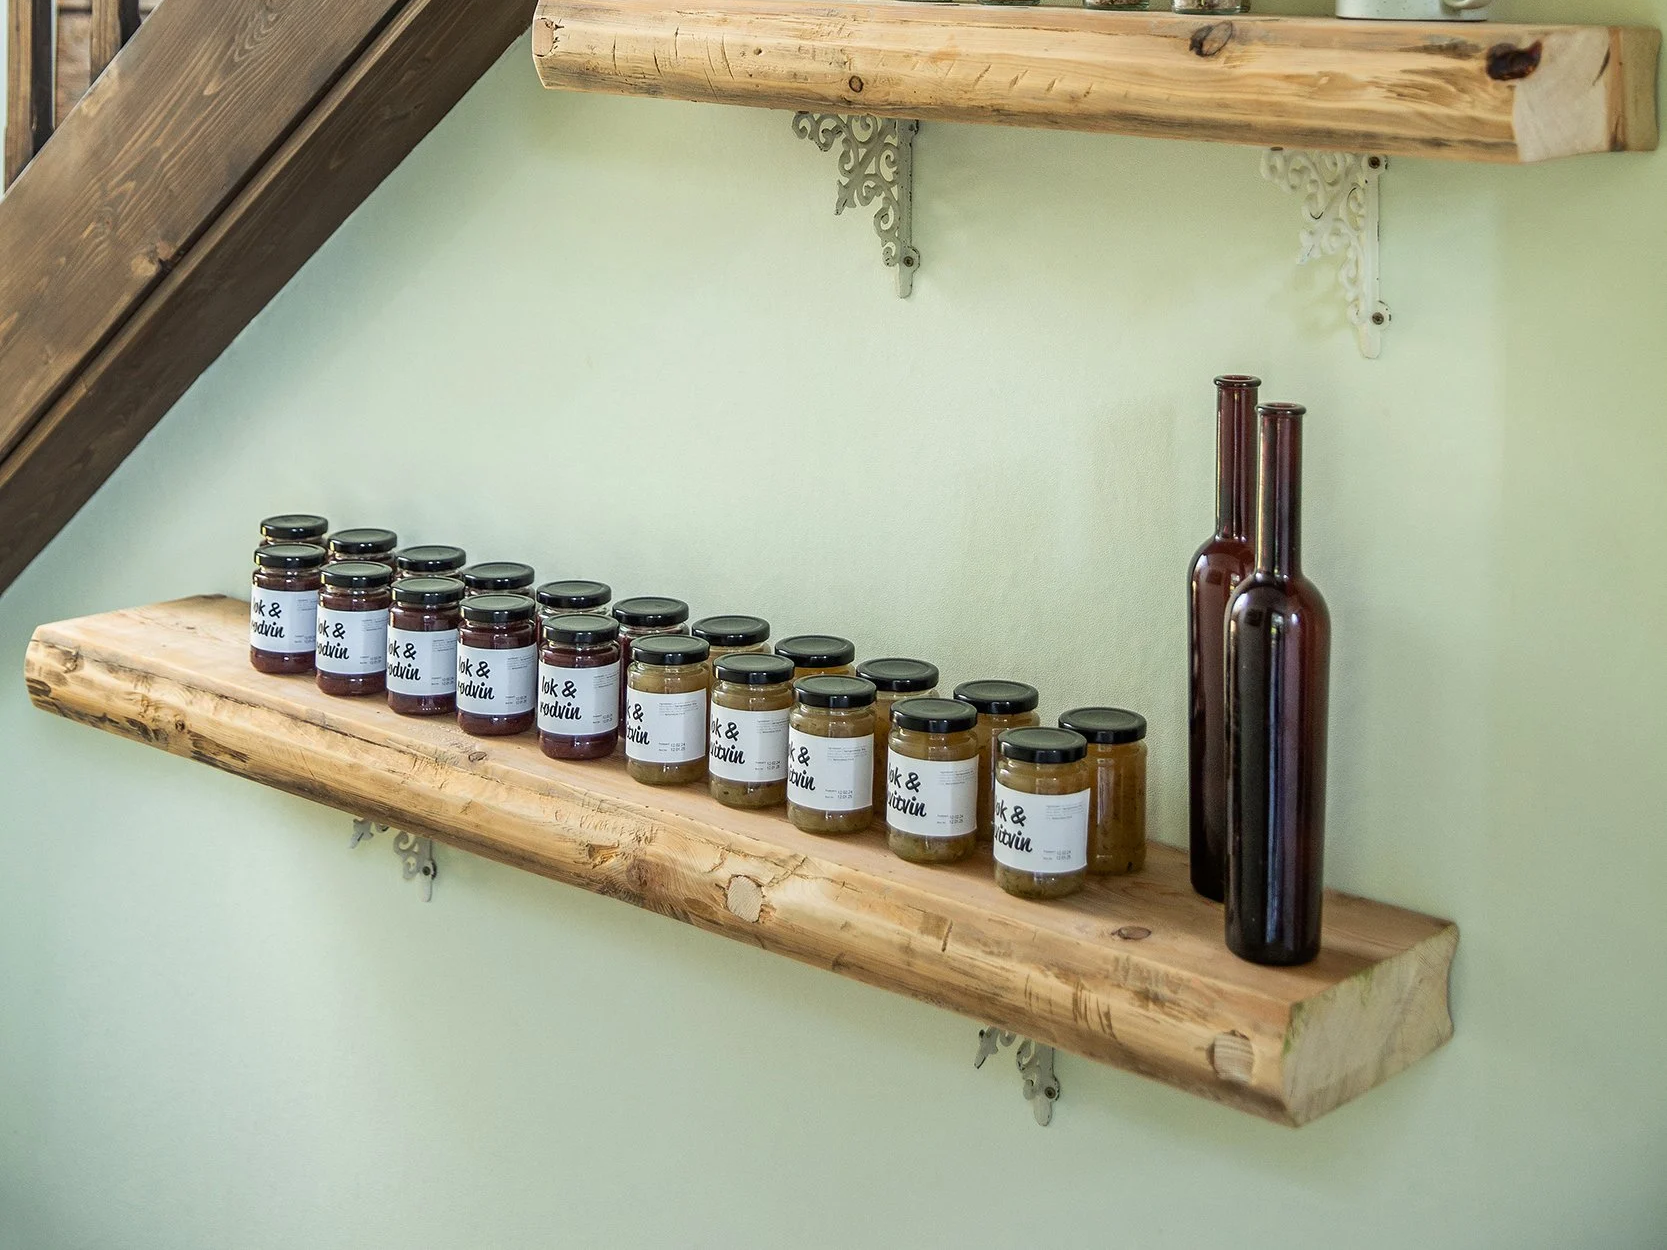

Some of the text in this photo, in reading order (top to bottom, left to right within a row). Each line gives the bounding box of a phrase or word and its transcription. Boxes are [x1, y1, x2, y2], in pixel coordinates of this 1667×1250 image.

[268, 602, 282, 619] &
[332, 622, 346, 640] &
[403, 642, 417, 660] &
[475, 661, 491, 679] &
[541, 675, 558, 698] løk
[561, 680, 578, 699] &
[539, 701, 582, 720] rødvin
[632, 703, 645, 723] &
[724, 721, 740, 742] &
[797, 746, 811, 767] &
[904, 772, 921, 793] &
[1010, 805, 1027, 827] &
